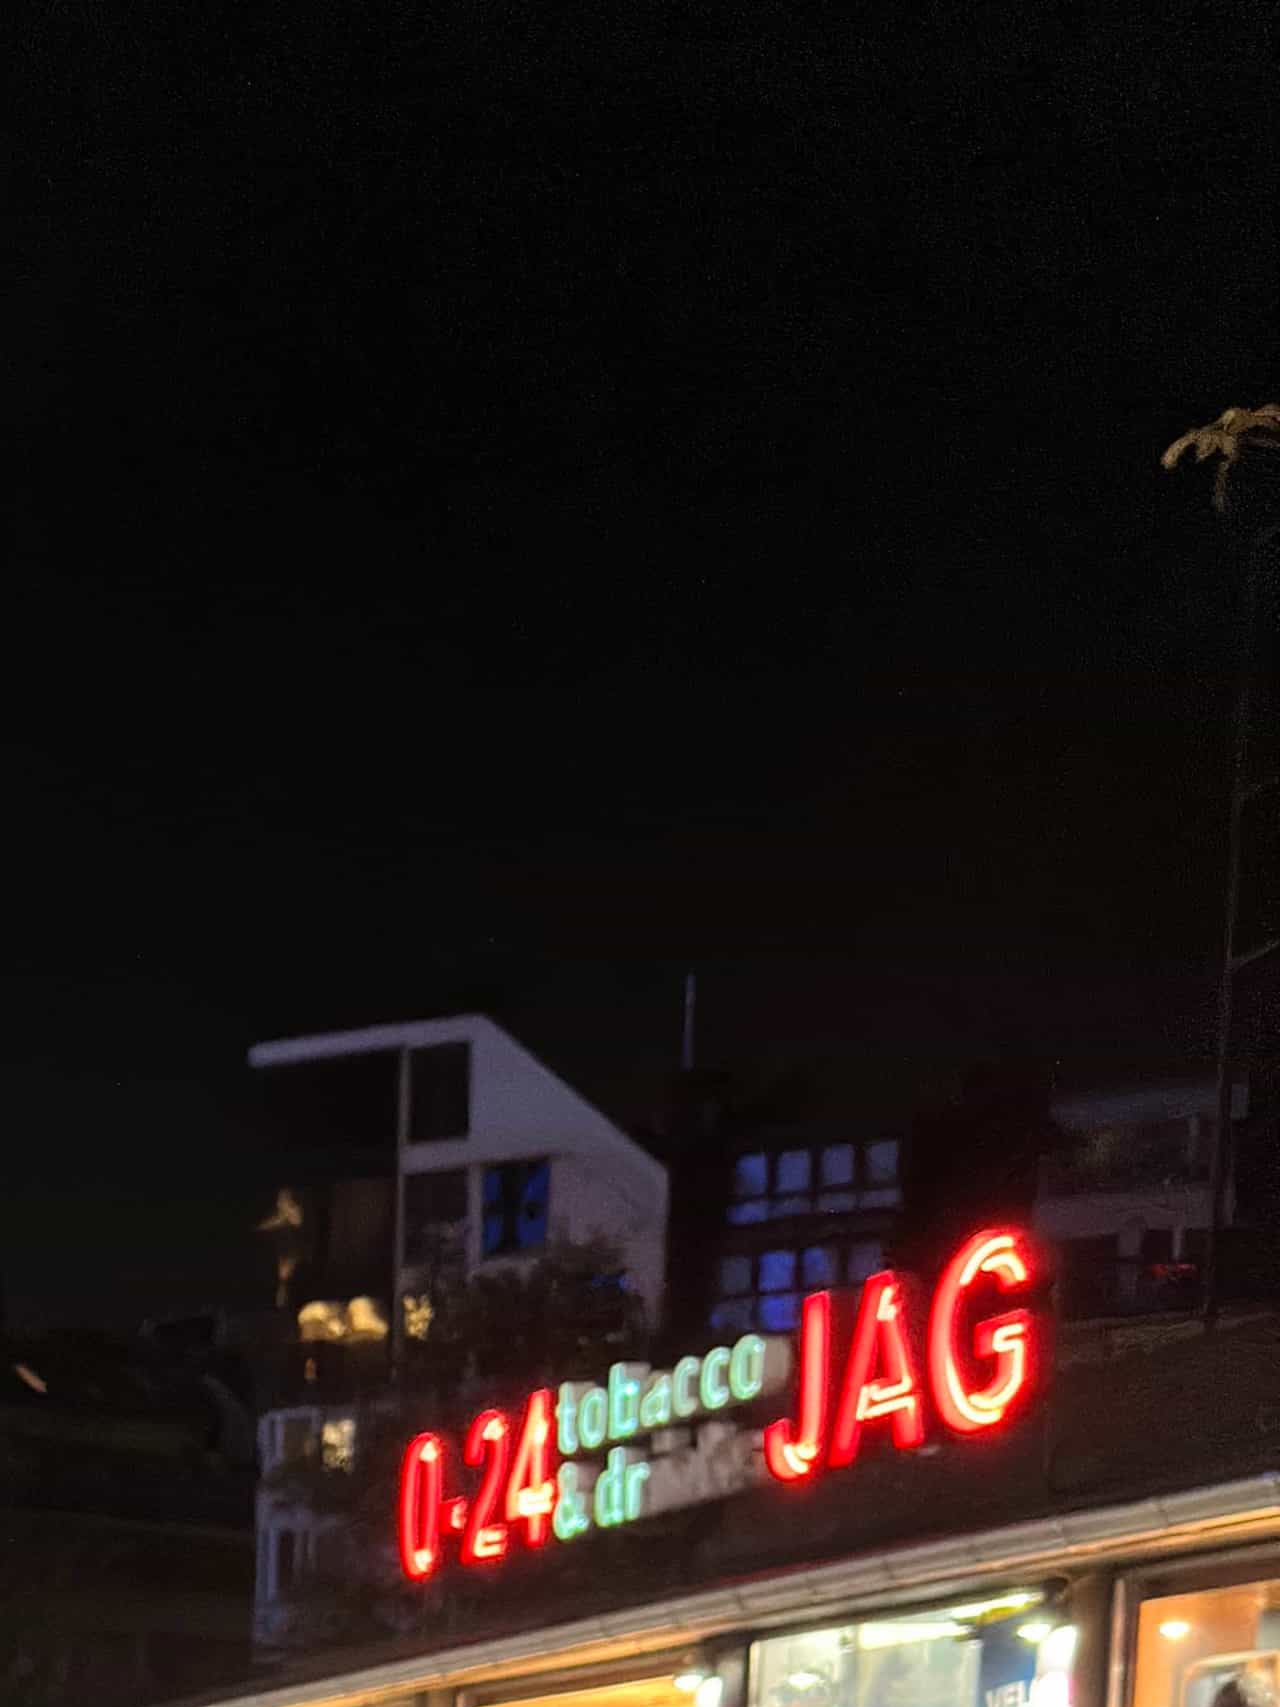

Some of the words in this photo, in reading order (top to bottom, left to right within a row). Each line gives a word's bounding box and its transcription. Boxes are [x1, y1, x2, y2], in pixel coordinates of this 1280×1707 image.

[555, 1333, 767, 1455] tobacco
[763, 1228, 1032, 1483] JAG
[399, 1388, 556, 1581] 0-24
